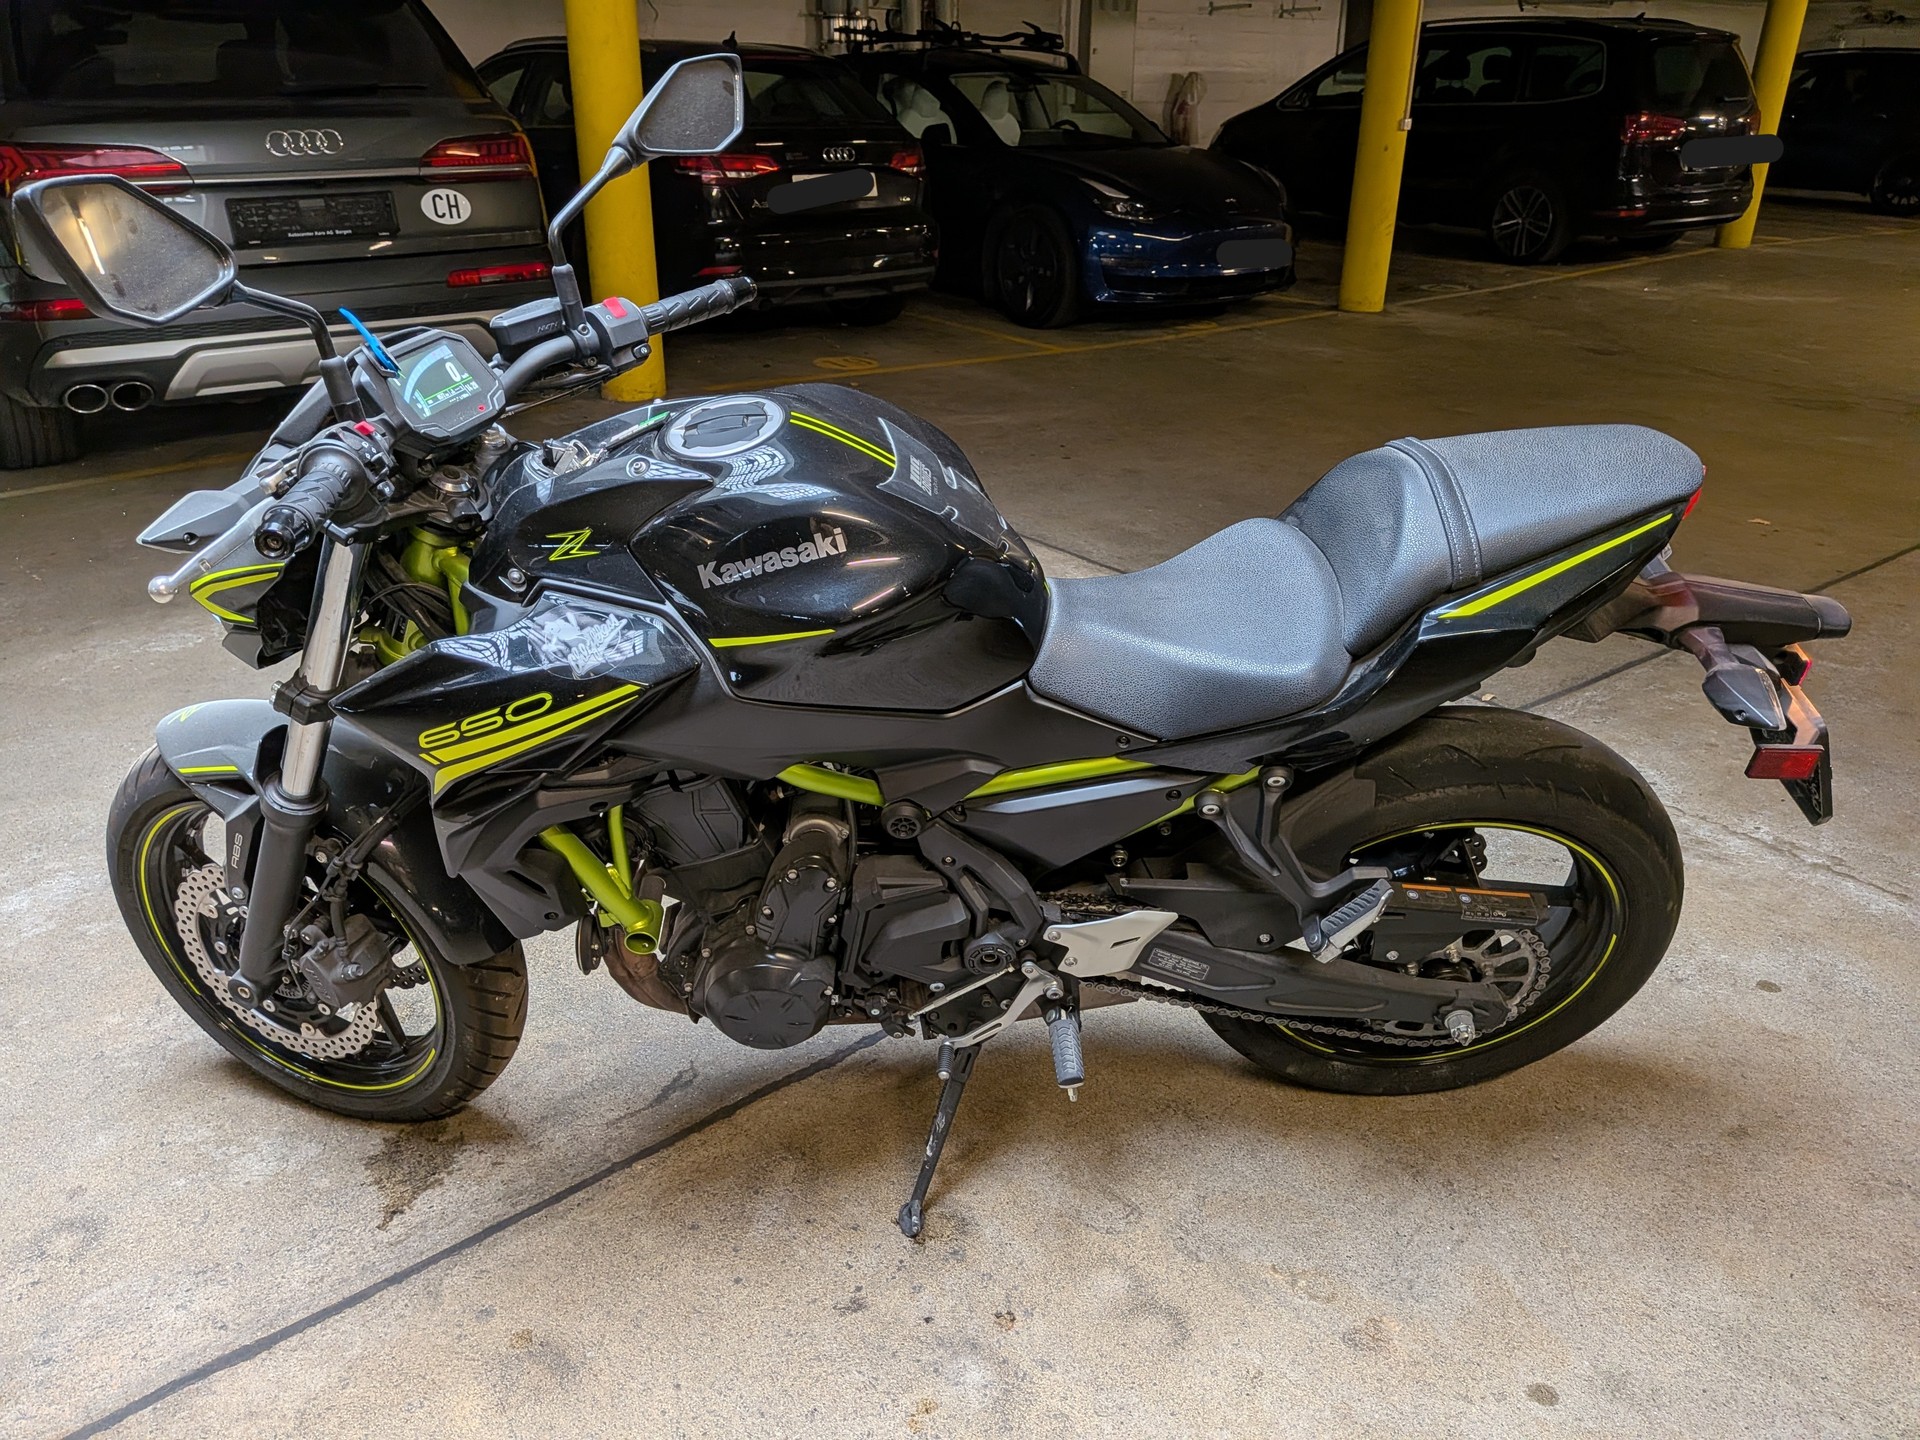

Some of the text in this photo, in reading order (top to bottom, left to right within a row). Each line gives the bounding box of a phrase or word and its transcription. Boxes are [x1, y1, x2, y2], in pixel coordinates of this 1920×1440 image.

[432, 194, 461, 219] CH
[444, 361, 461, 382] 0
[545, 527, 600, 561] Z
[697, 527, 847, 589] Kawasaki
[418, 692, 553, 749] 650
[231, 833, 243, 869] ABS
